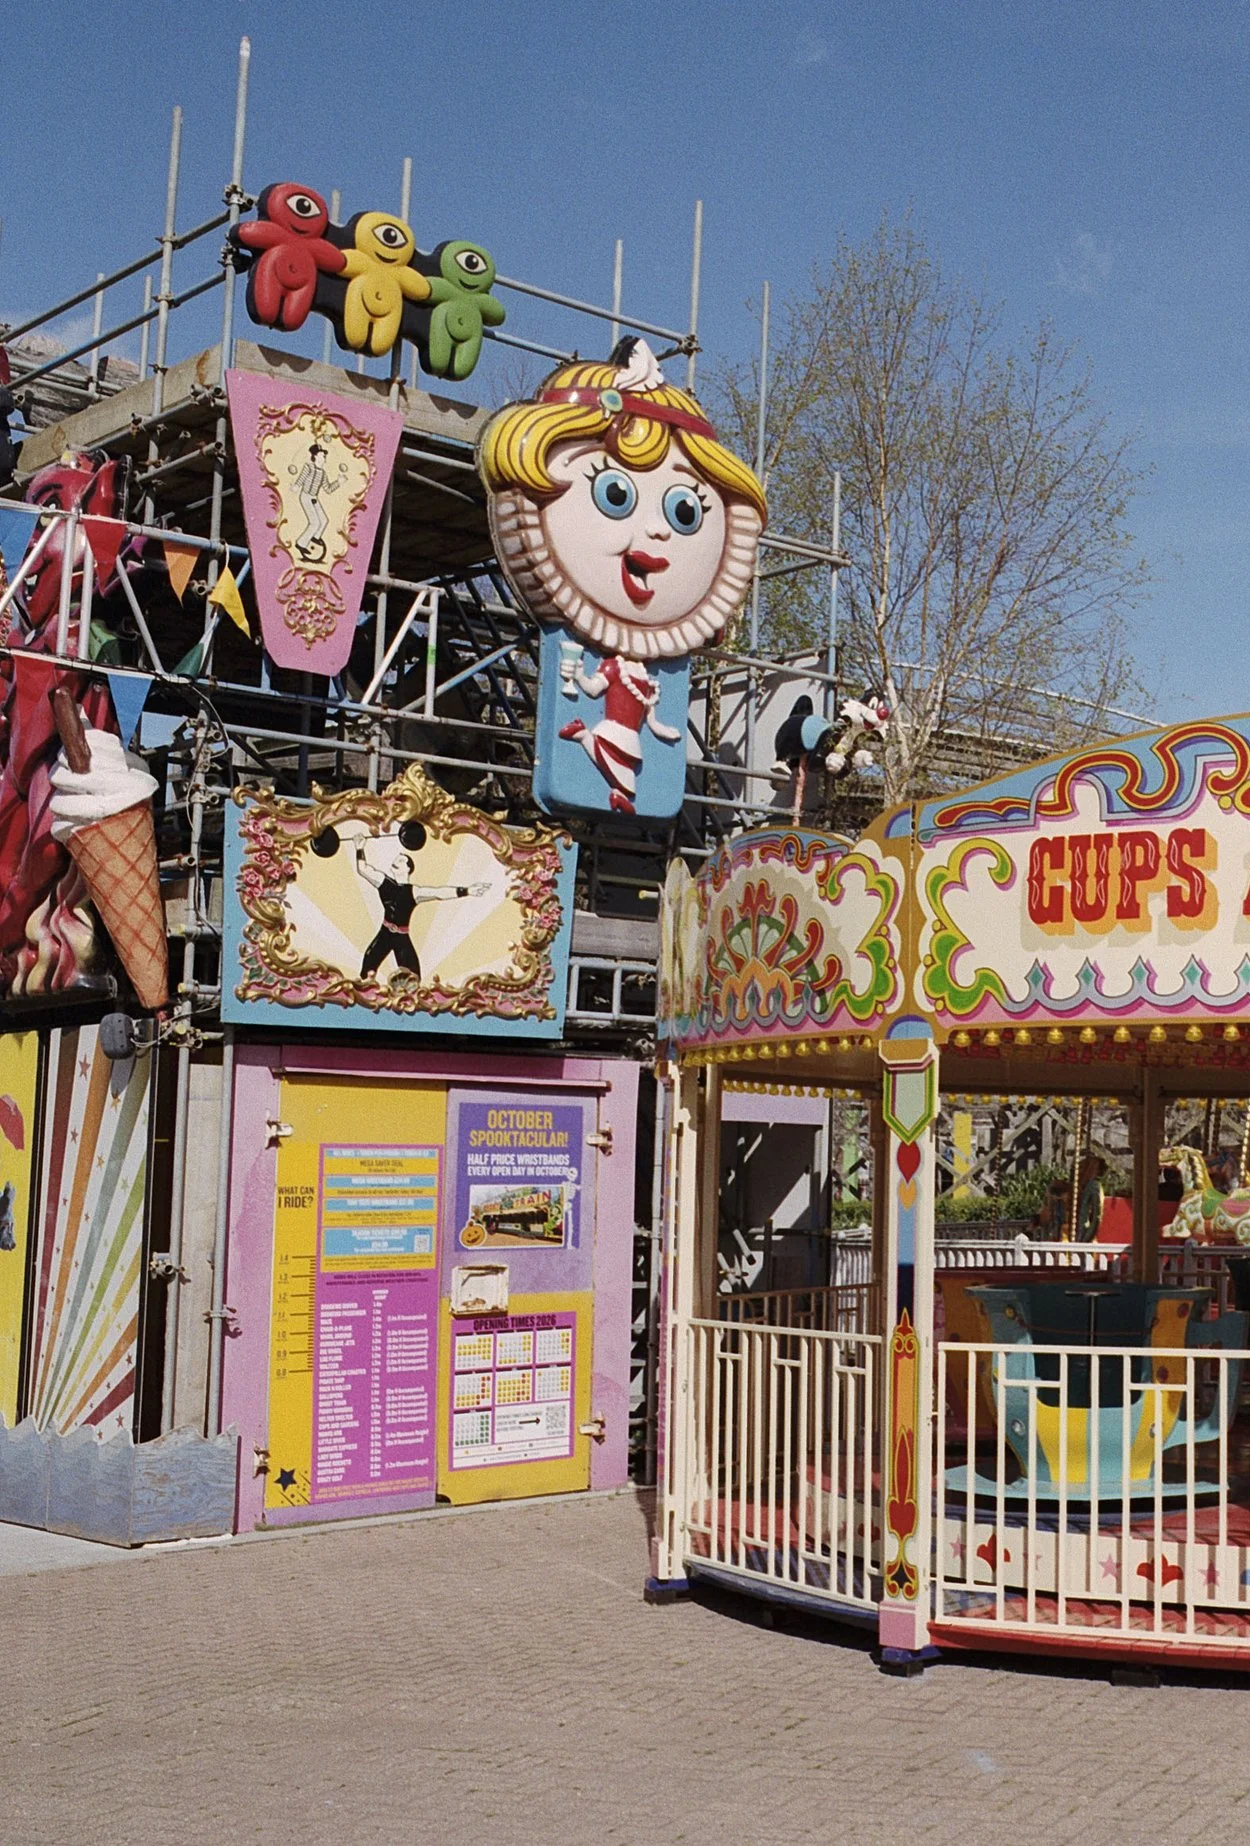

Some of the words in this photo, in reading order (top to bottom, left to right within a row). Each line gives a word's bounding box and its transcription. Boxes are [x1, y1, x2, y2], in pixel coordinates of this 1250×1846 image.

[1027, 828, 1216, 932] CUPS
[488, 1109, 553, 1129] OCTOBER
[469, 1130, 569, 1148] SPOOKTACULAR!
[467, 1153, 490, 1165] HALF
[491, 1154, 516, 1165] PRICE
[518, 1154, 570, 1165] WRISTBANDS
[467, 1166, 490, 1176] EVERY
[492, 1166, 512, 1176] OPEN
[512, 1166, 526, 1176] DAY
[527, 1166, 535, 1176] IN
[536, 1166, 568, 1176] OCTOBER
[278, 1186, 298, 1195] WHAT
[300, 1186, 314, 1194] CAN
[278, 1196, 282, 1208] I
[284, 1196, 314, 1208] RIDE?
[474, 1318, 510, 1331] OPENING
[511, 1316, 534, 1328] TIMES
[536, 1314, 557, 1326] 2026
